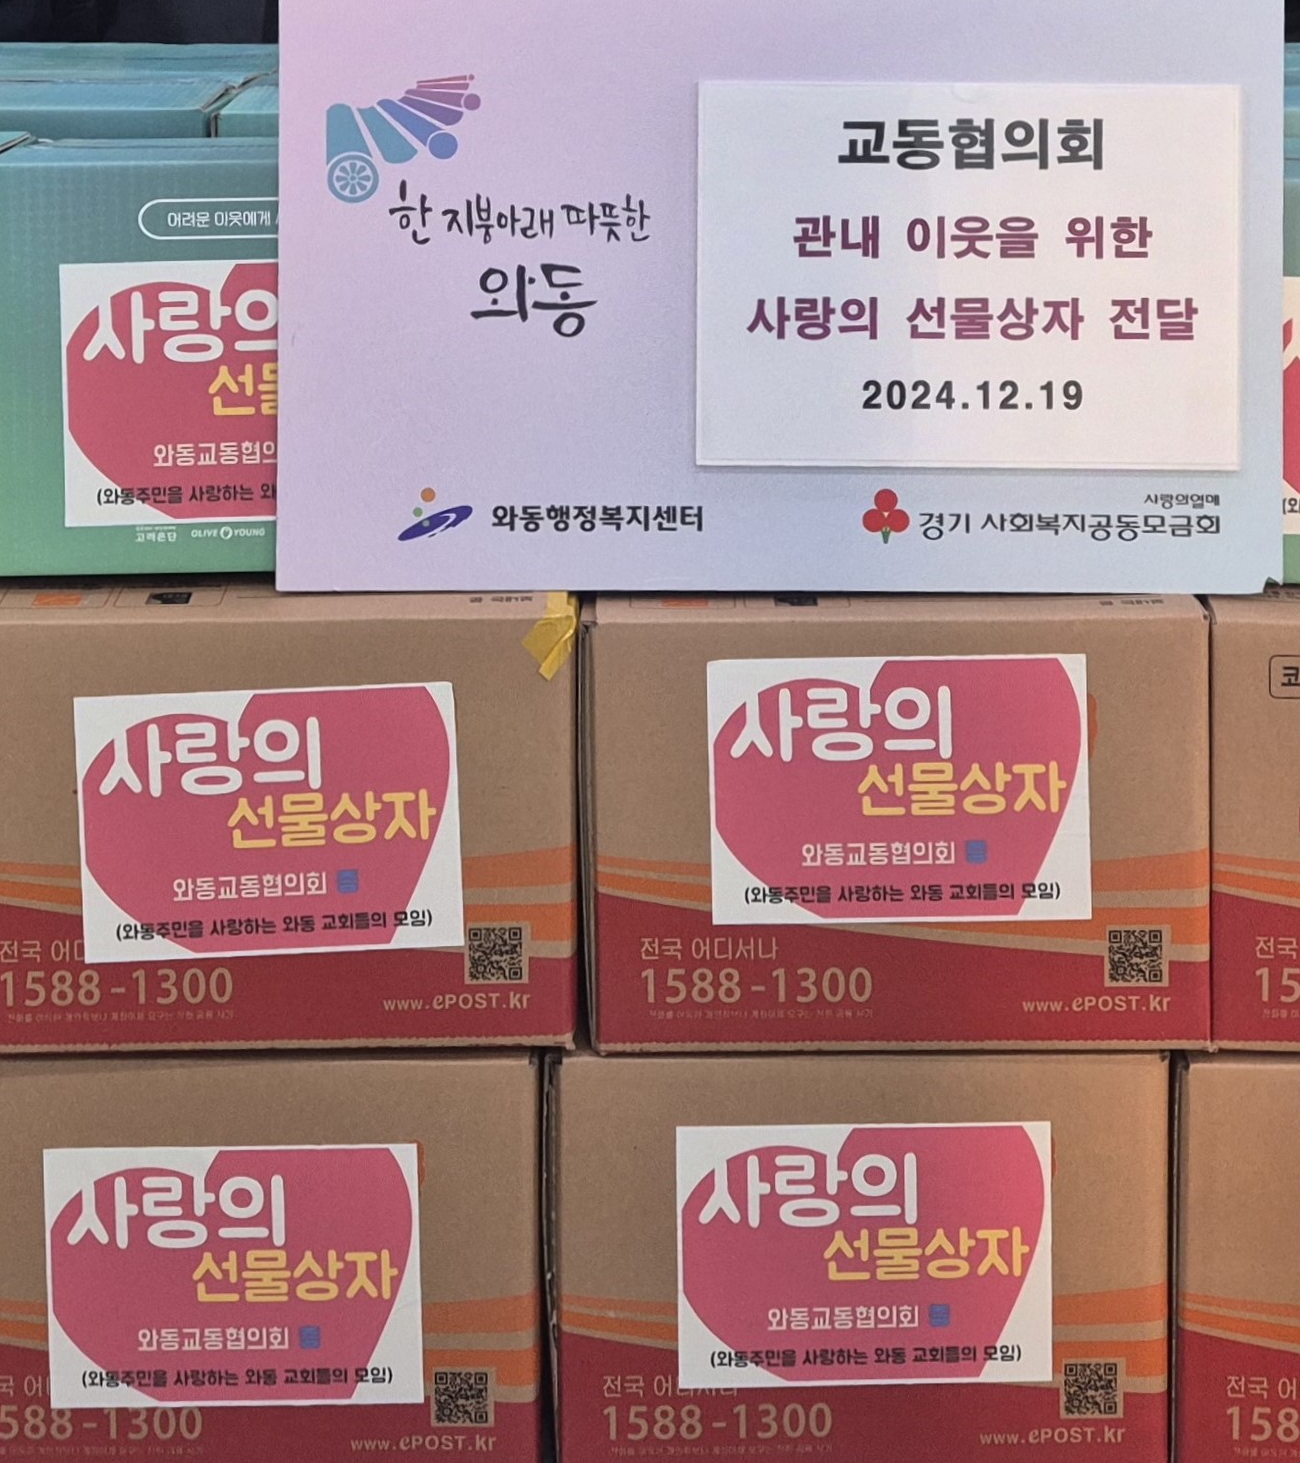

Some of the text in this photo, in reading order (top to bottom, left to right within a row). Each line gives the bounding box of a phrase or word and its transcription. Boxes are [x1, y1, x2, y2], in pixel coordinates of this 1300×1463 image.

[837, 117, 1106, 171] 교동협의회
[388, 179, 651, 245] 한 지붕아래 따뜻한
[793, 215, 1153, 260] 관내 이웃을 위한
[469, 263, 599, 339] 와동
[746, 296, 1199, 341] 사랑의 선물상자 전달
[861, 380, 1084, 411] 2024.12.19
[154, 440, 278, 466] 와동교동협의
[491, 503, 704, 534] 와동행정복지센터
[1143, 493, 1220, 507] 사랑의열매
[918, 511, 1221, 542] 경기 사회복지공동모금회
[730, 685, 951, 761] 사랑의
[100, 716, 321, 797] 사랑의
[858, 761, 1066, 815] 선물상자
[228, 790, 436, 848] 선물상자
[803, 841, 955, 865] 와동교동협의회
[174, 871, 326, 901] 와동교동협의회
[746, 881, 1060, 905] (와동주민을 사랑하는 와동 교회들의 모임)
[641, 937, 779, 960] 전국 어디서나
[0, 967, 234, 1007] 1588-1300
[382, 992, 532, 1011] www.ePOST.kr
[641, 966, 873, 1004] 1588-1300
[1022, 995, 1172, 1012] www.ePOST.kr
[699, 1152, 917, 1227] 사랑의
[67, 1174, 285, 1249] 사랑의
[824, 1227, 1029, 1280] 선물상자
[193, 1249, 398, 1302] 선물상자
[768, 1305, 918, 1330] 와동교동협의회
[139, 1326, 288, 1350] 와동교동협의회
[711, 1344, 1021, 1369] (와동주민을 사랑하는 와동 교회들의 모임)
[603, 1402, 833, 1441] 1588-1300
